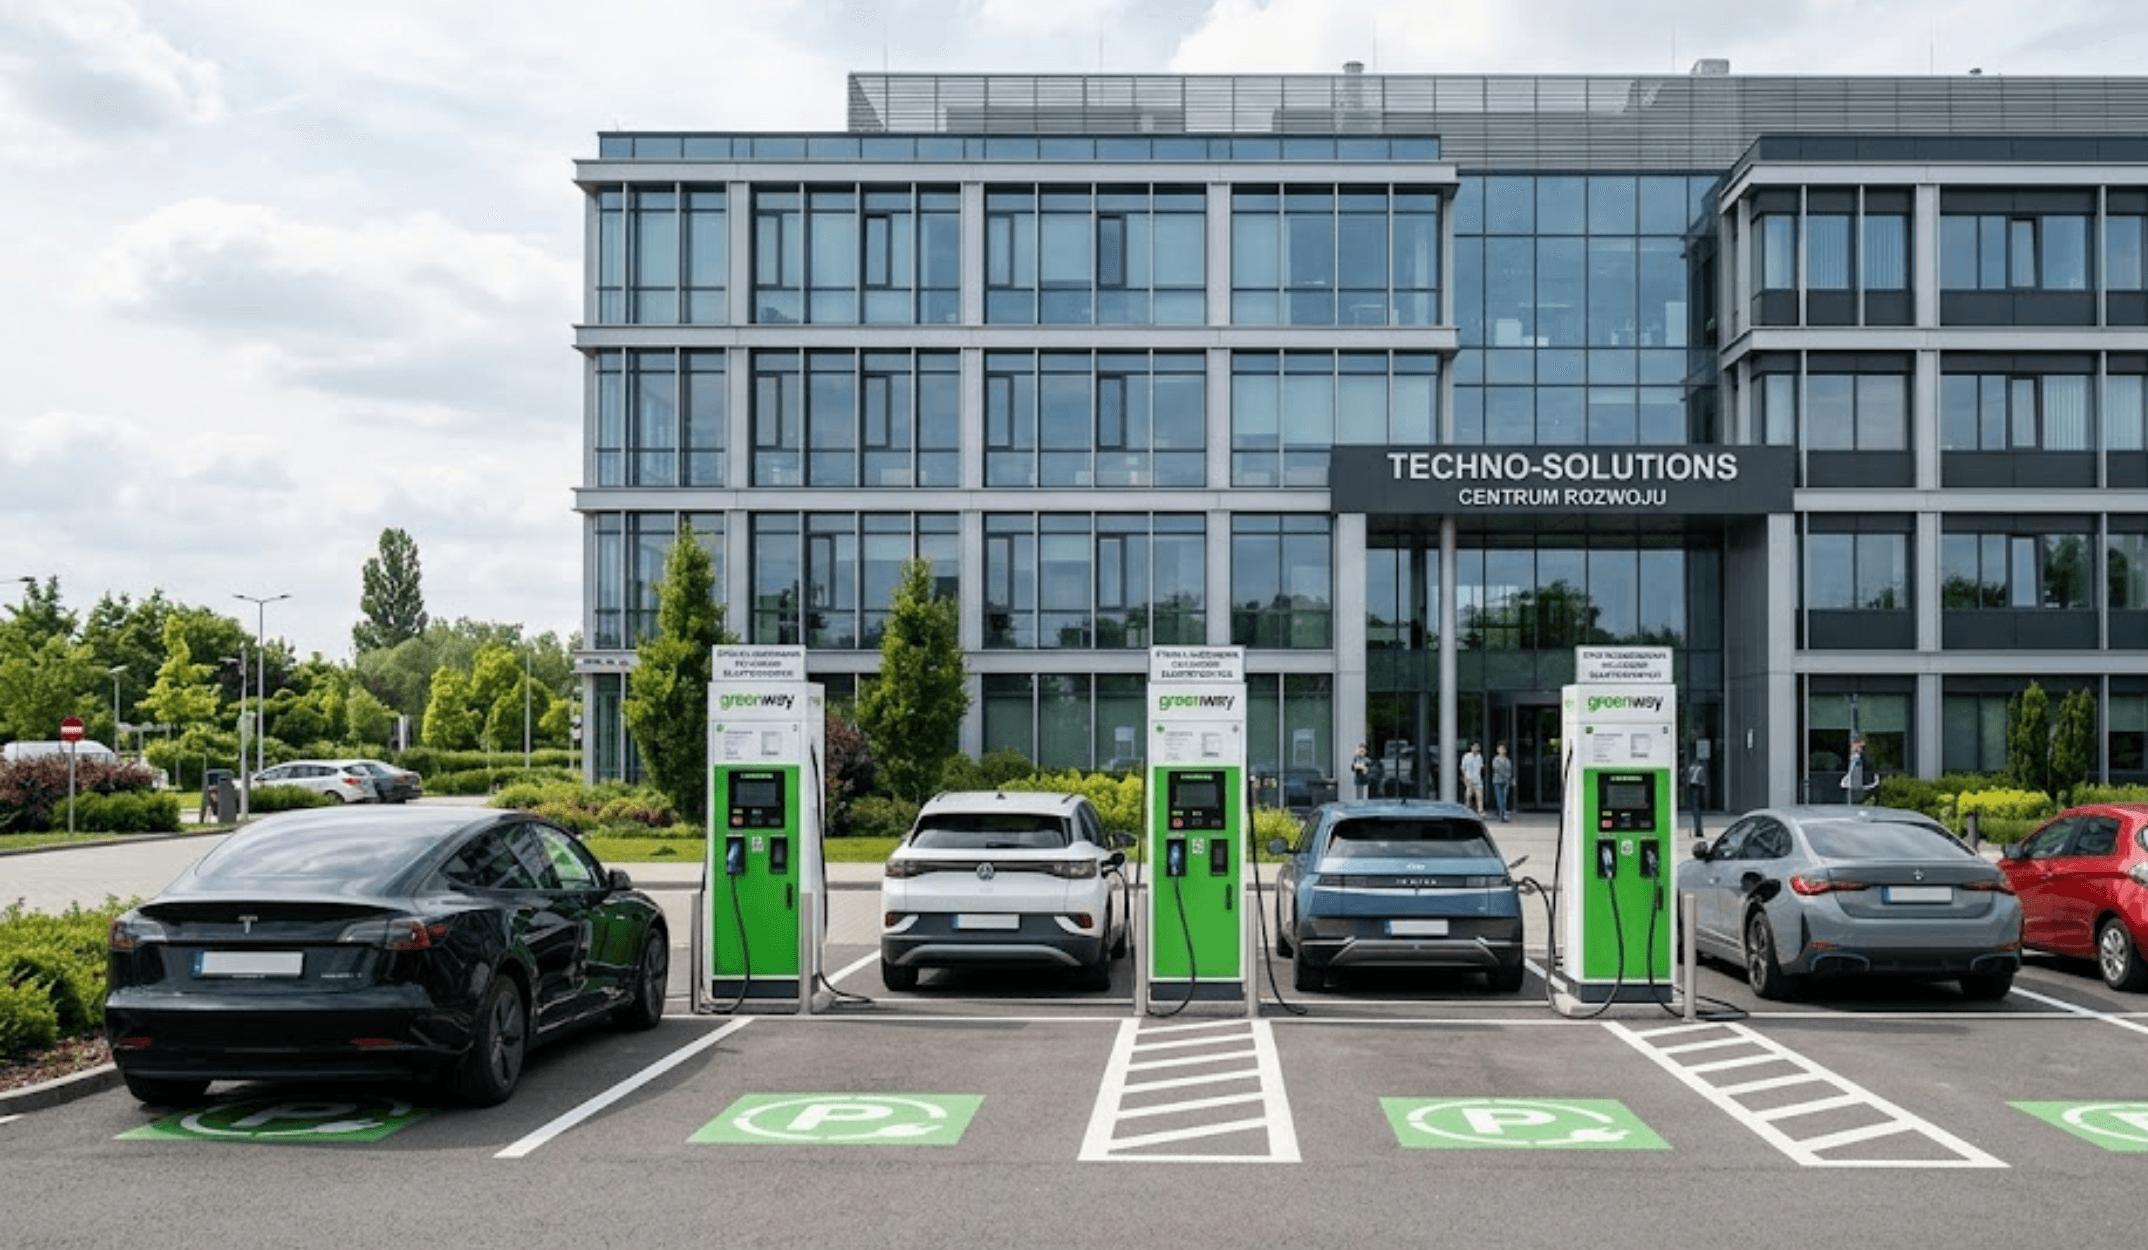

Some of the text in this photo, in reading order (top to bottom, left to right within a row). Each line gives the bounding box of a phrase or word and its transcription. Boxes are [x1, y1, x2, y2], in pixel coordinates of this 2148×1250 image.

[1387, 453, 1738, 480] TECHNO-SOLUTIONS
[1458, 488, 1667, 506] CENTRUM ROZWOJU
[719, 694, 795, 710] greenway
[786, 1103, 893, 1130] P
[1461, 1108, 1556, 1134] P
